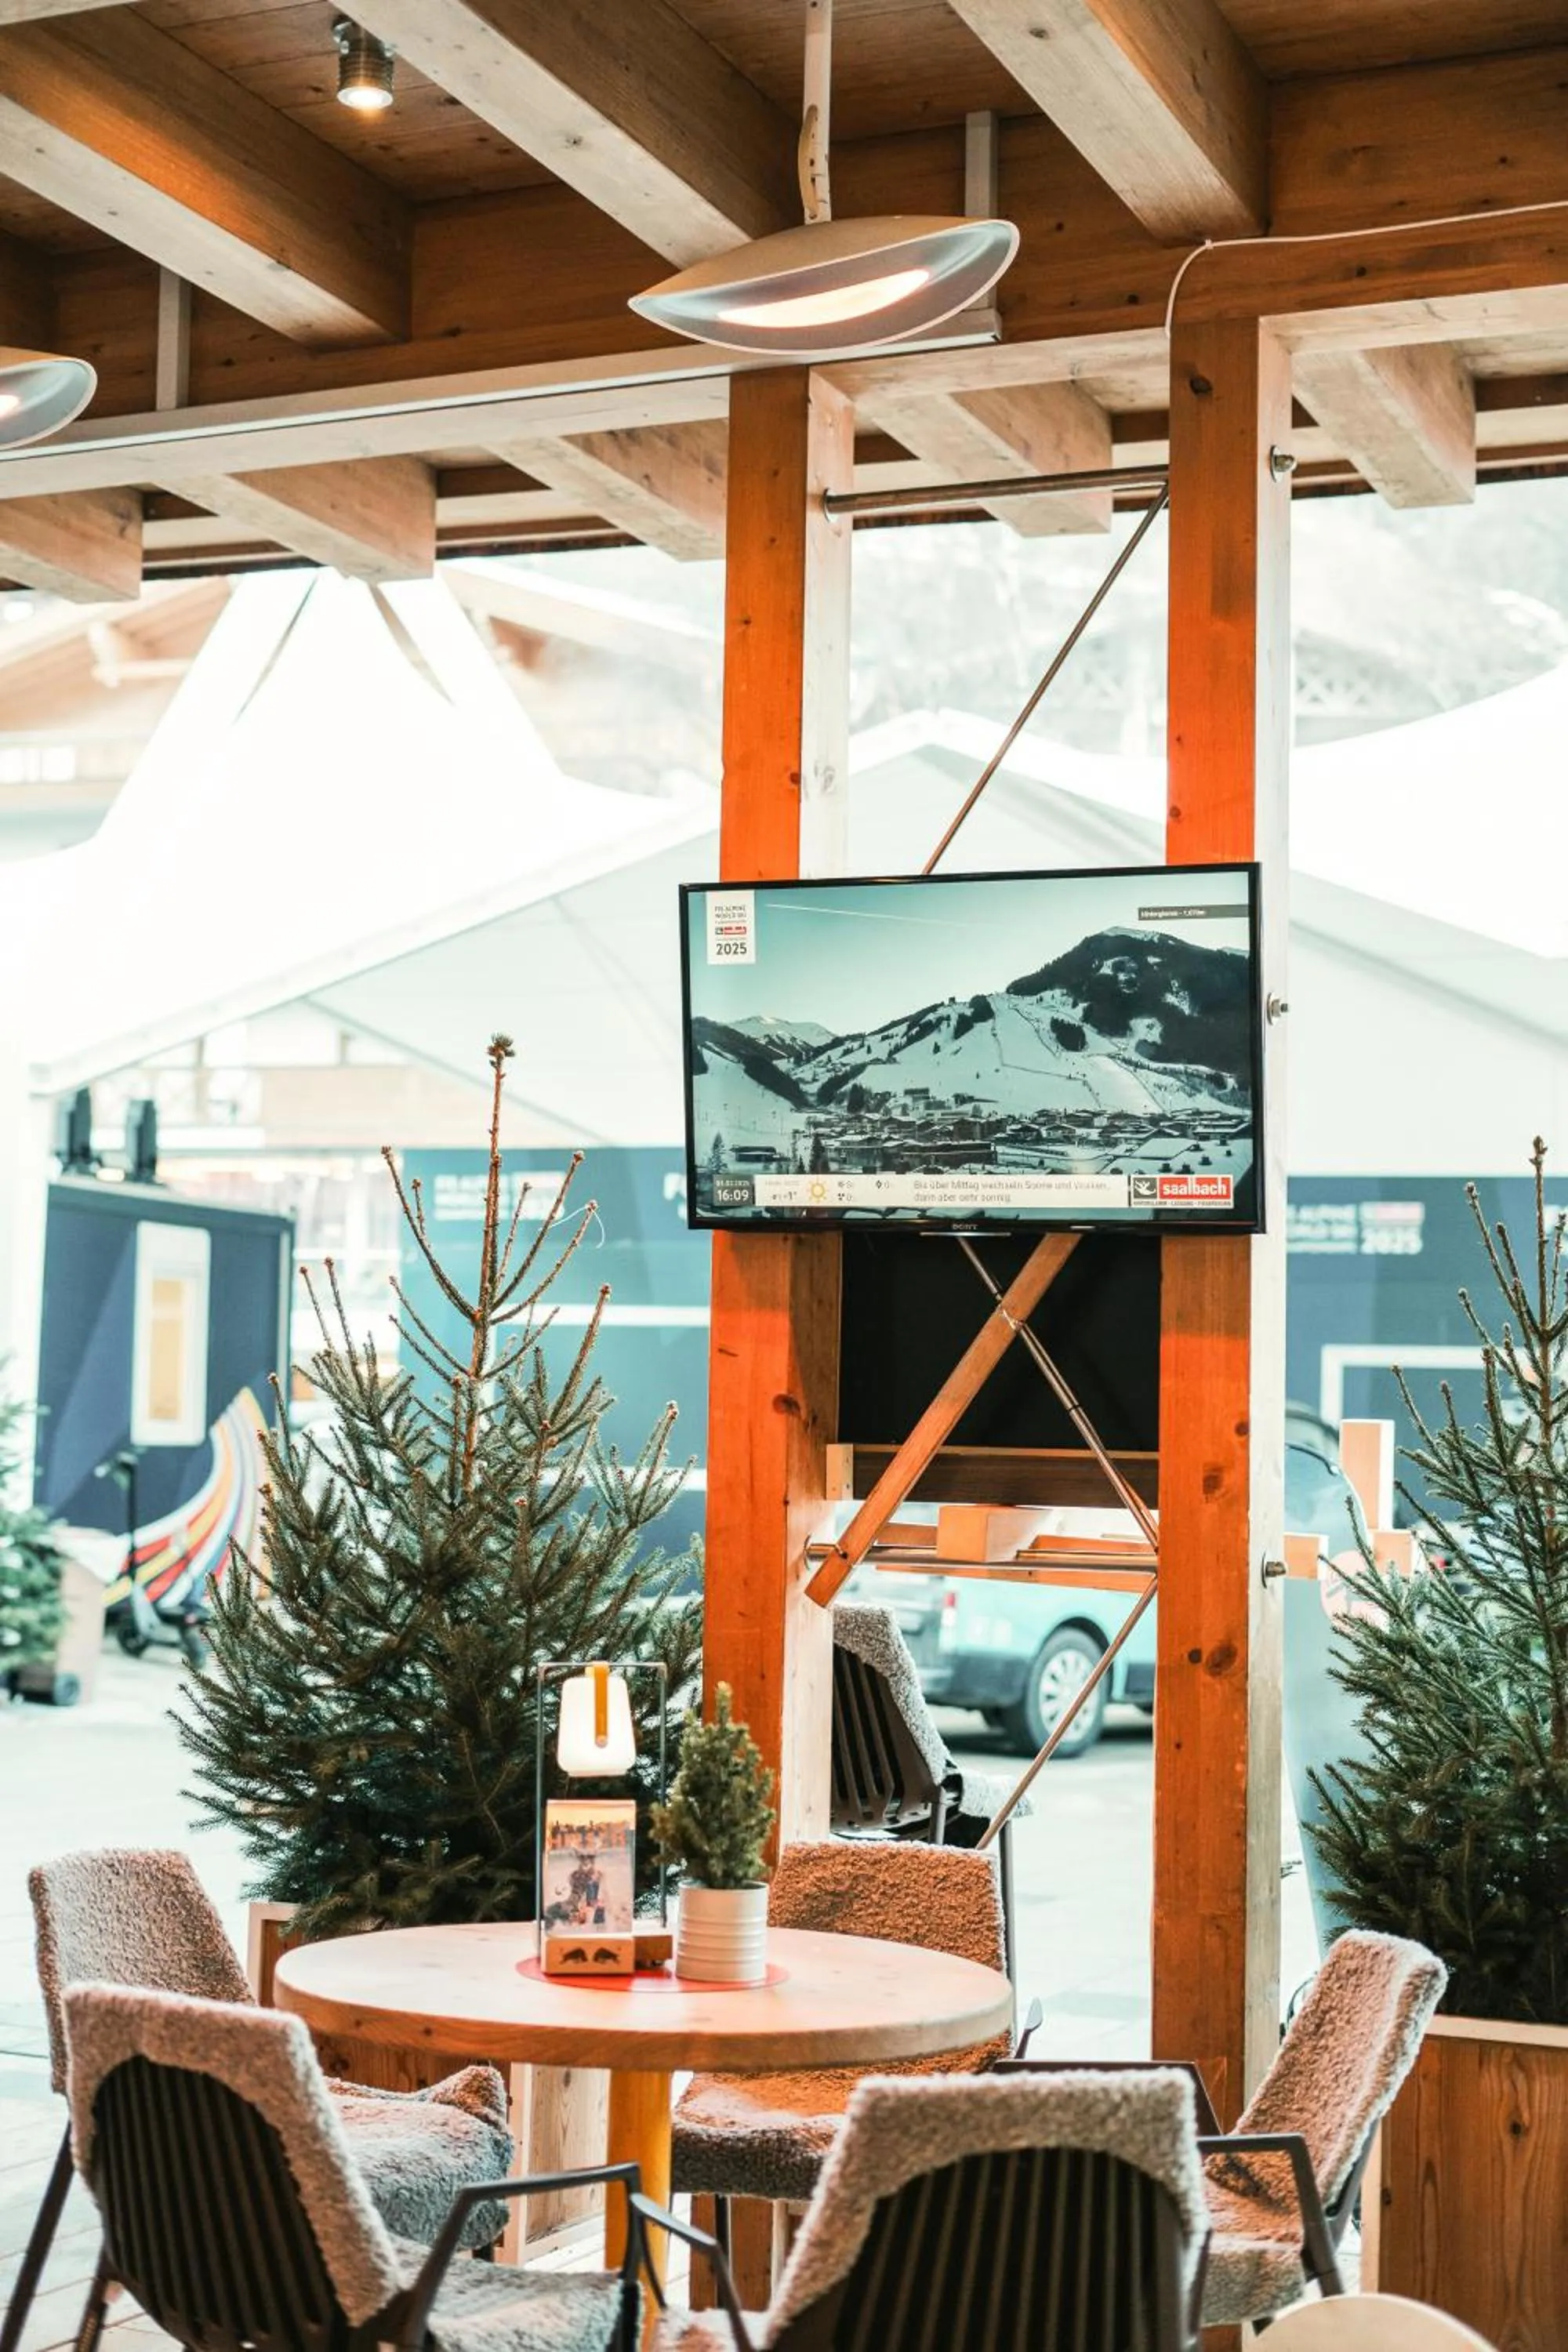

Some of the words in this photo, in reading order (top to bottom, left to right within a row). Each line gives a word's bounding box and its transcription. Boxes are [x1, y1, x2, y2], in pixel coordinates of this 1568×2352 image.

[716, 942, 747, 955] 2025
[1163, 1178, 1227, 1195] saalbach
[717, 1189, 749, 1201] 16:09
